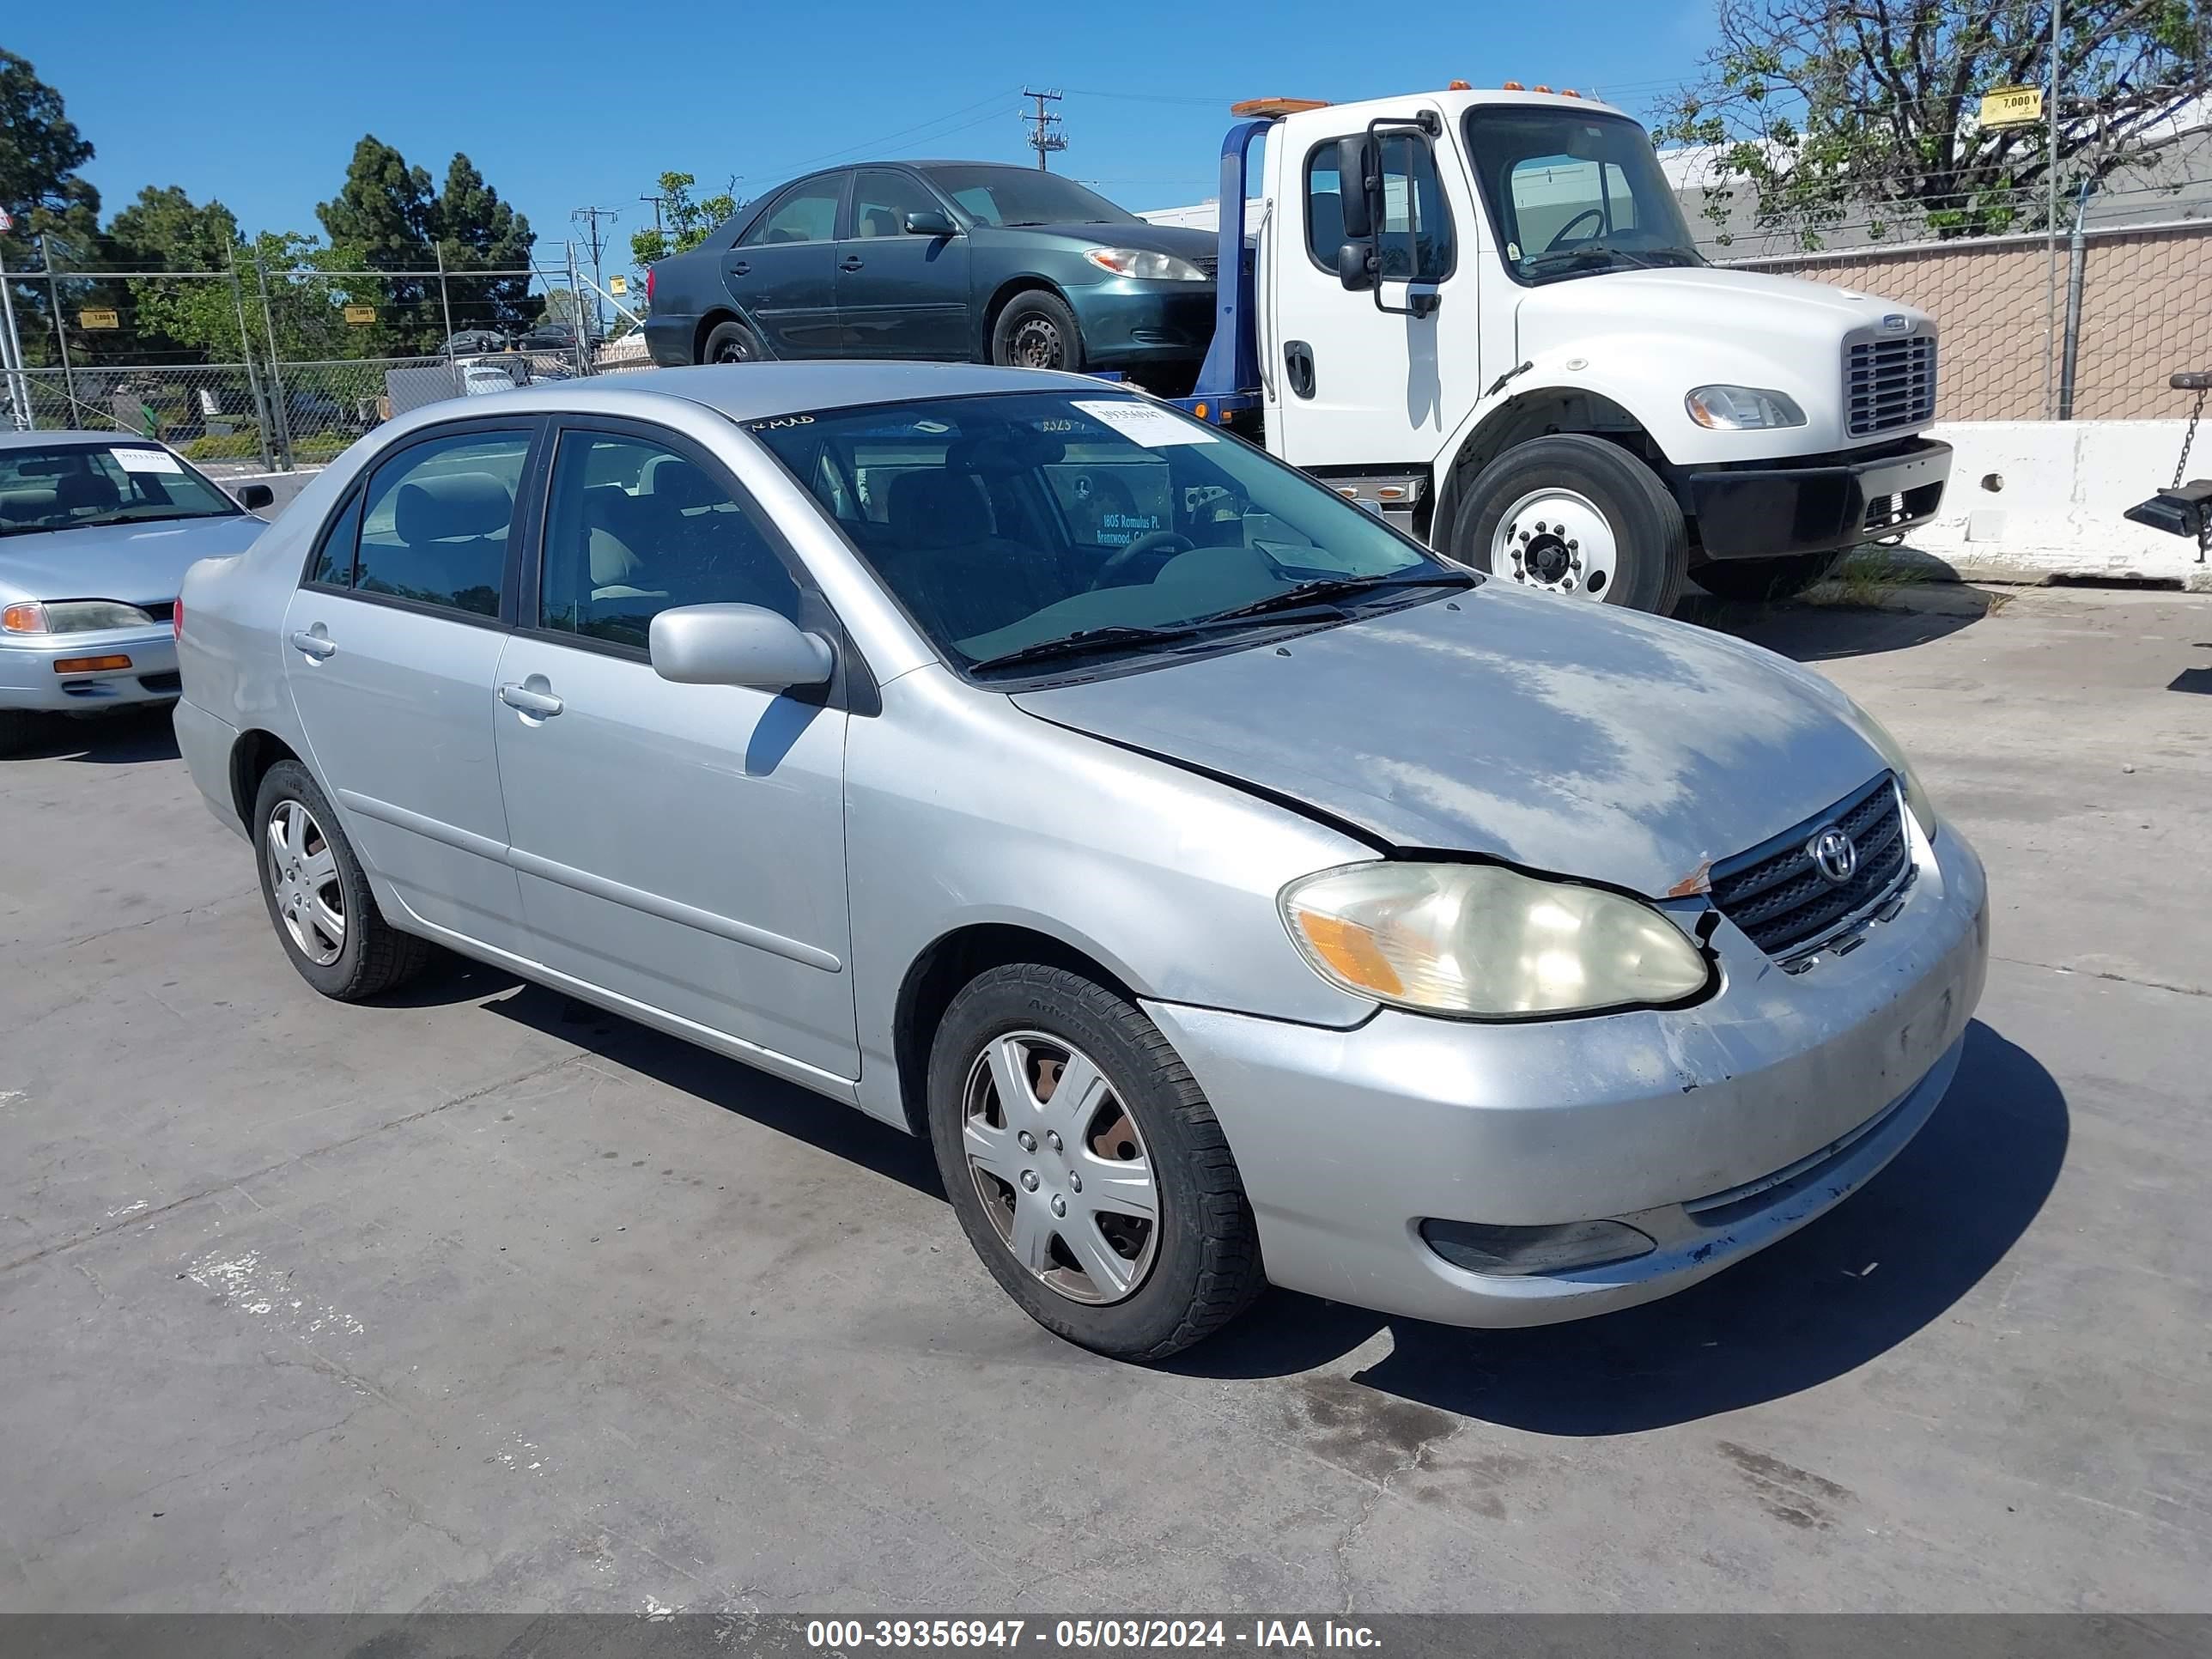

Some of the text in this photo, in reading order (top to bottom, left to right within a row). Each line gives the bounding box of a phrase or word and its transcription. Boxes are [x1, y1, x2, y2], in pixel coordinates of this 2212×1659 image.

[2003, 95, 2030, 109] 7,000
[2033, 94, 2039, 105] V
[1103, 514, 1160, 530] 1805 Romulus Pl.
